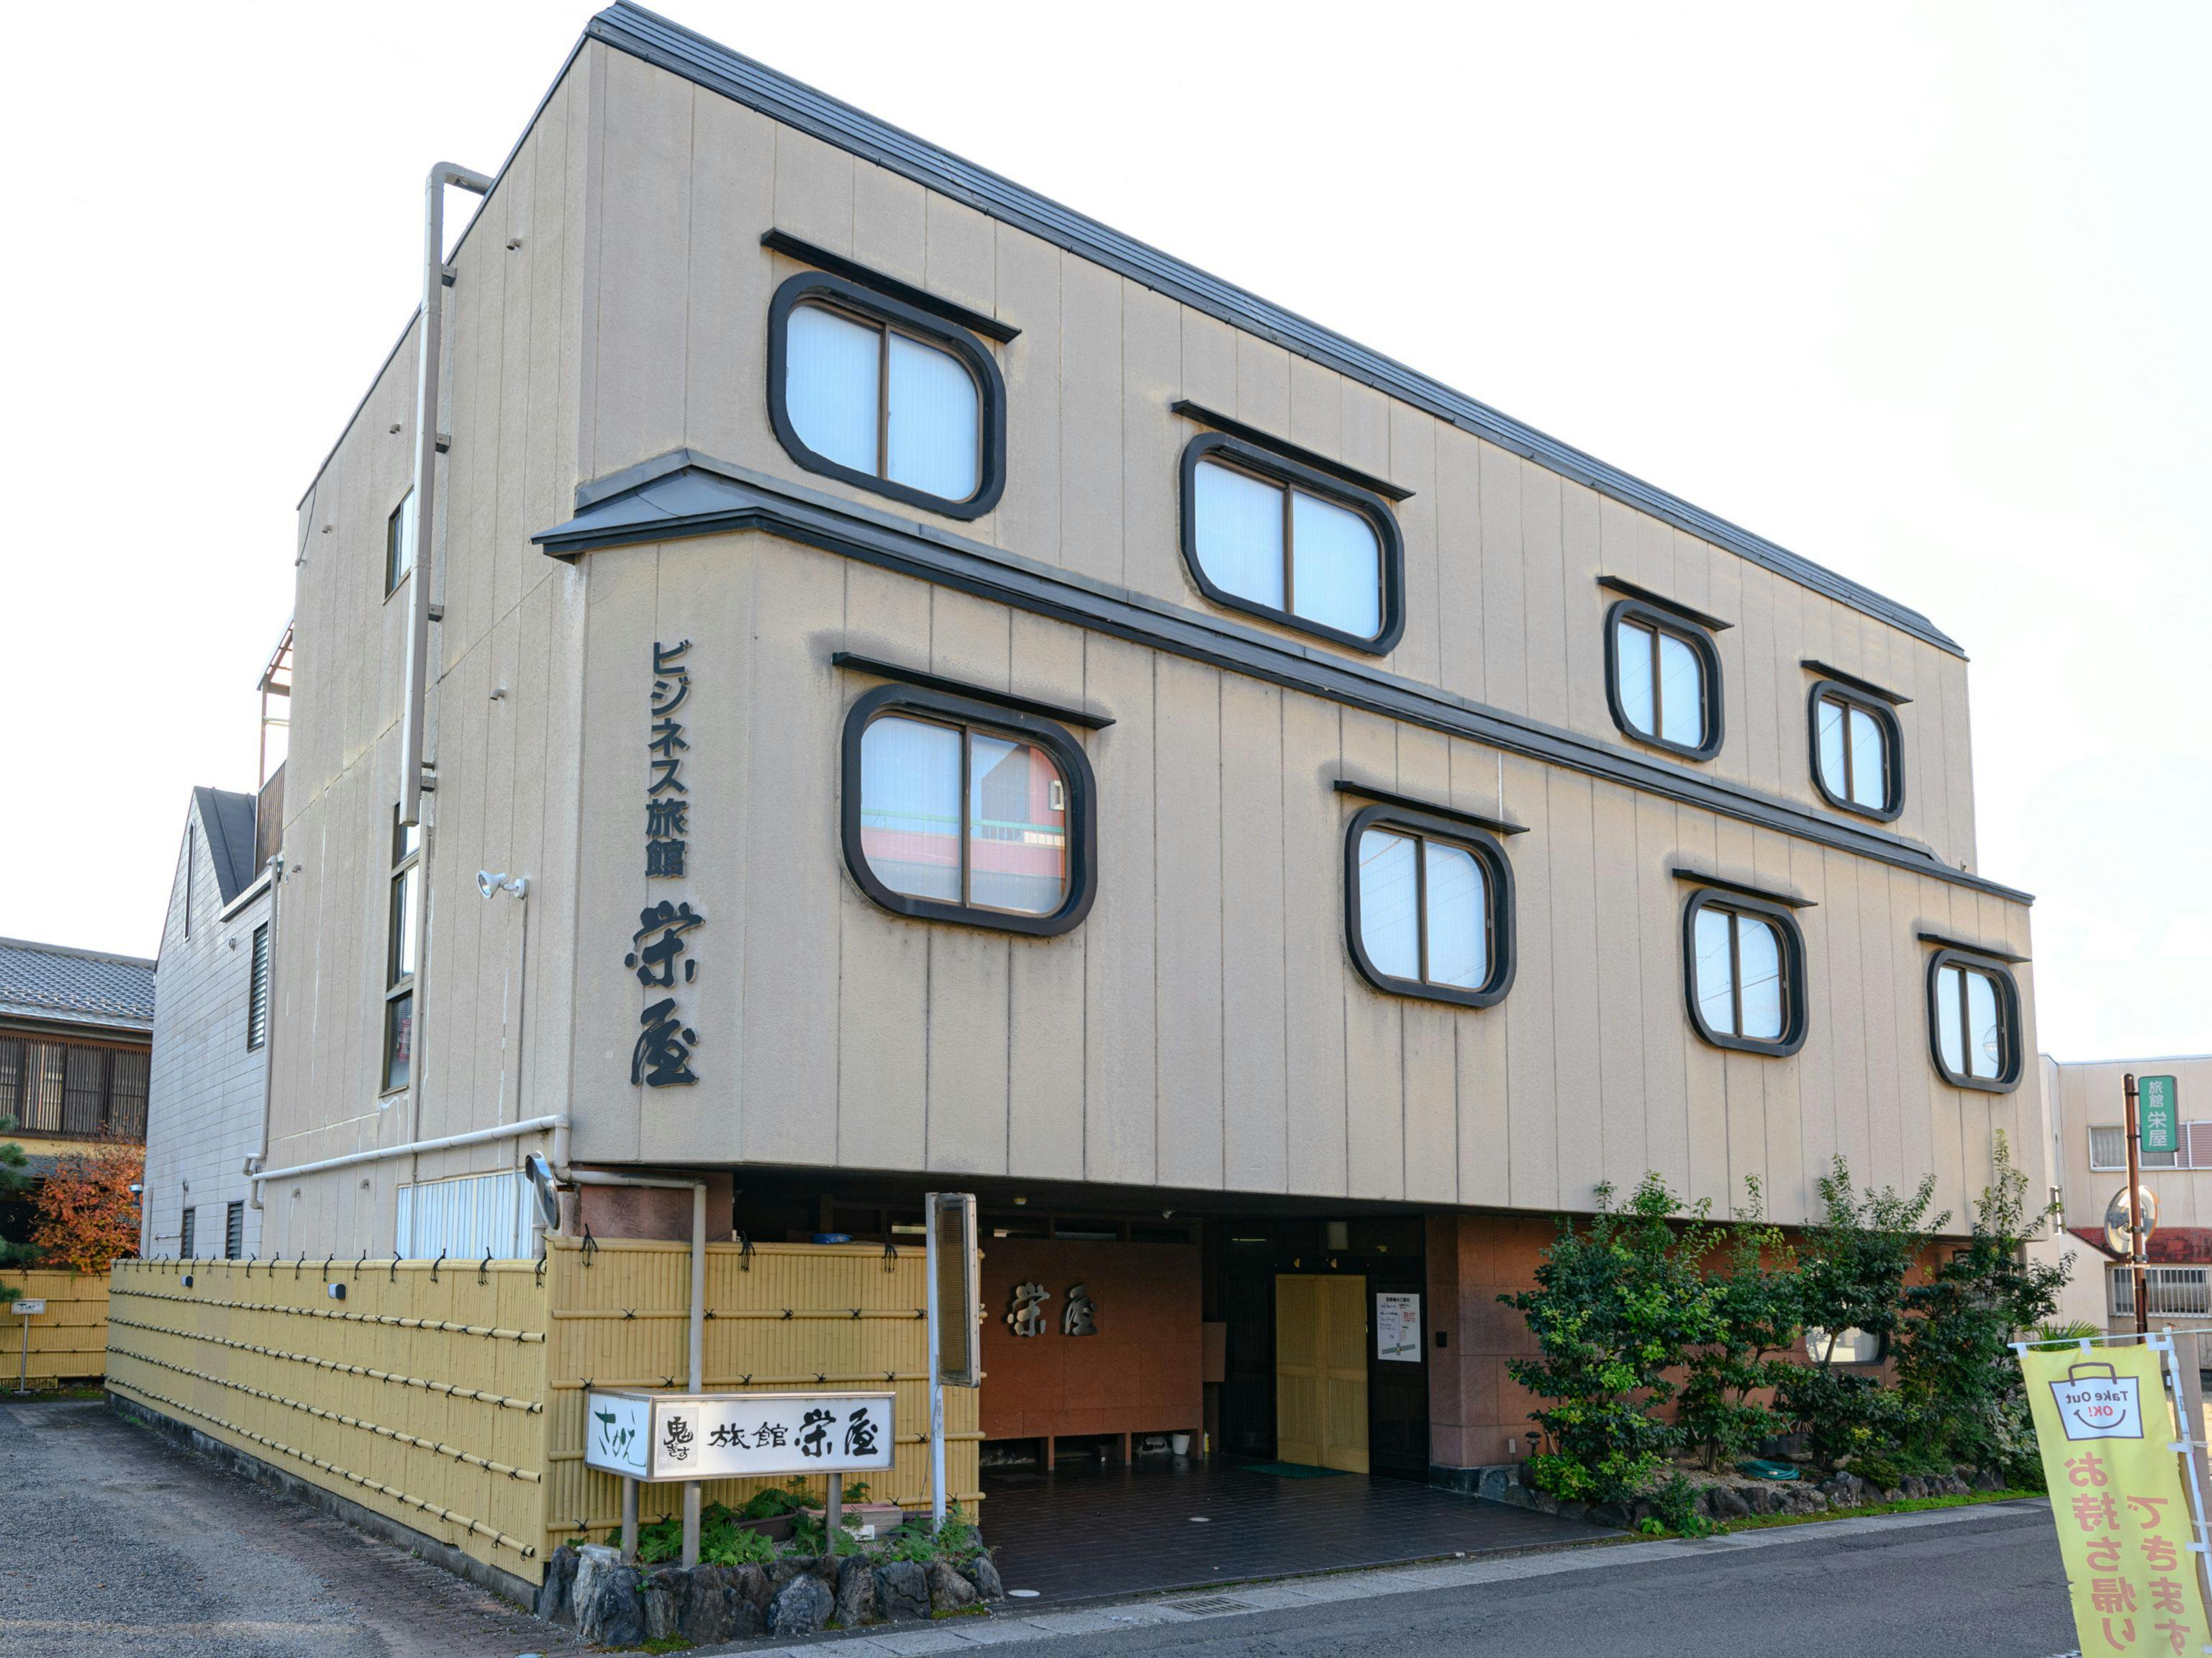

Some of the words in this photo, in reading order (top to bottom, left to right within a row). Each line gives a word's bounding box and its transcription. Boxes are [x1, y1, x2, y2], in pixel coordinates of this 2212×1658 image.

[645, 639, 692, 878] ビジネス旅館
[625, 900, 705, 1087] 栄屋
[2148, 1081, 2164, 1108] 旅館
[2148, 1111, 2167, 1147] 栄屋
[1007, 1282, 1099, 1337] 栄屋
[707, 1422, 789, 1449] 旅館
[794, 1408, 879, 1457] 栄屋
